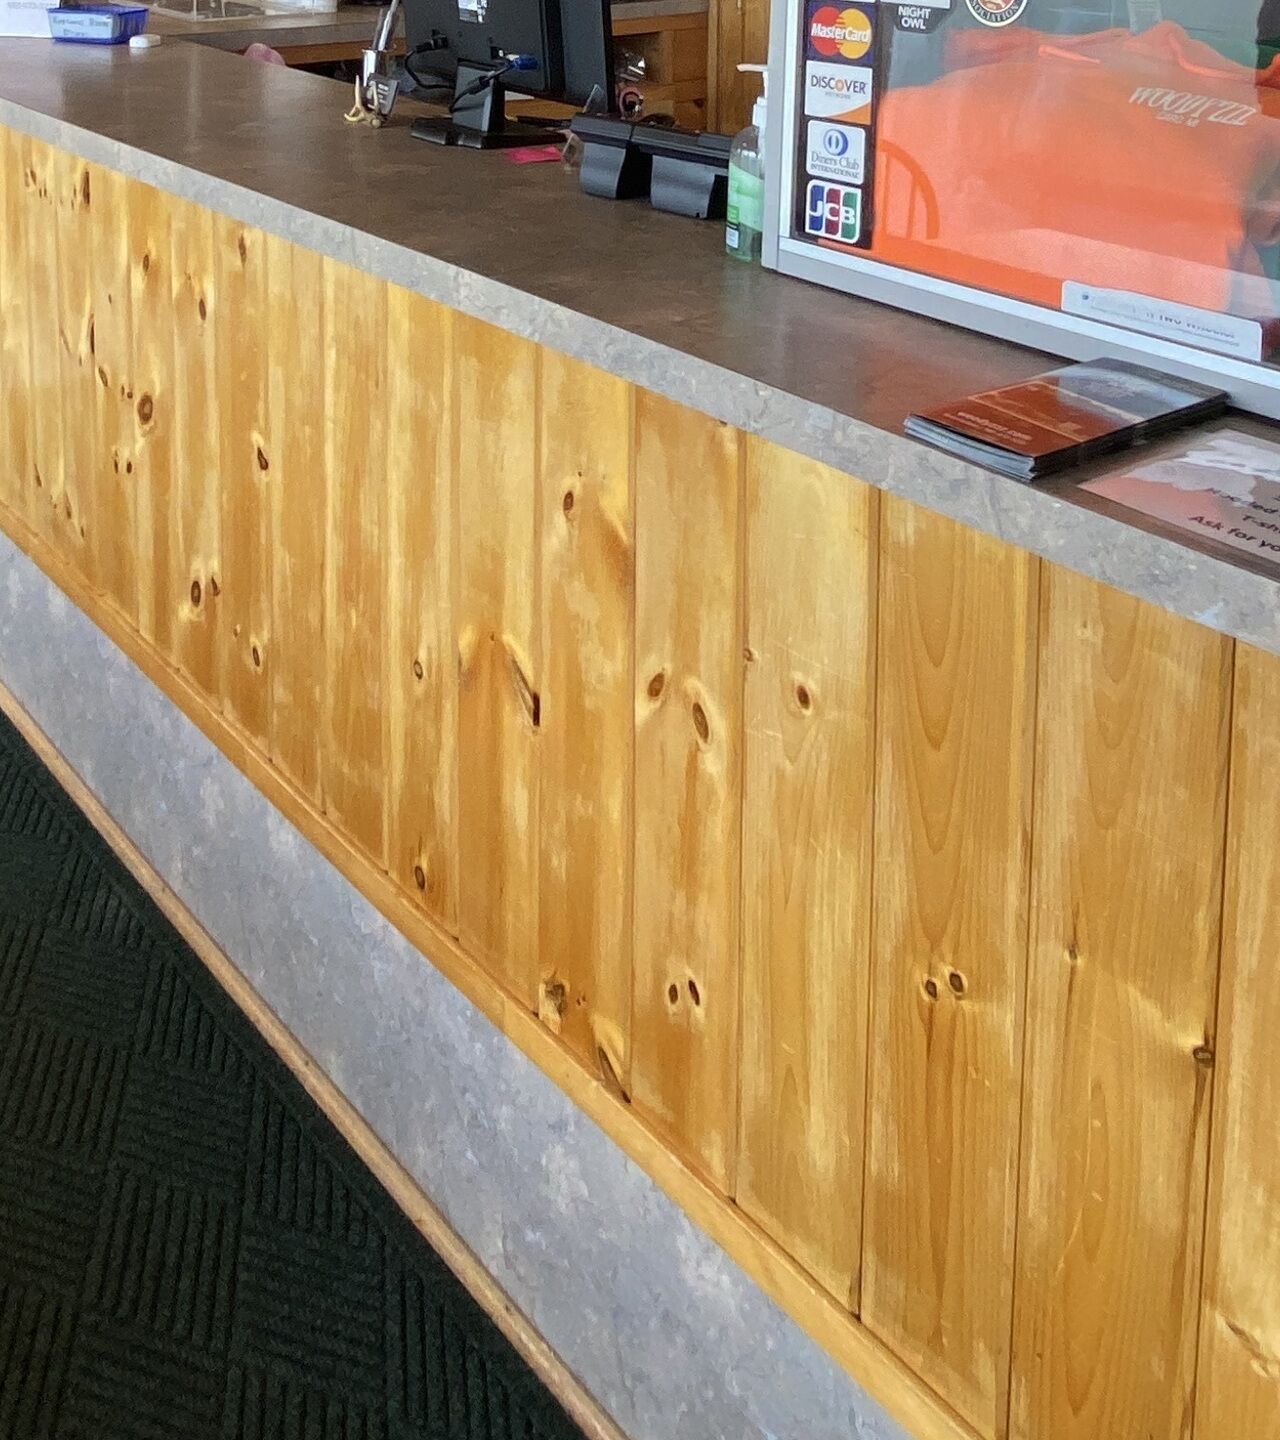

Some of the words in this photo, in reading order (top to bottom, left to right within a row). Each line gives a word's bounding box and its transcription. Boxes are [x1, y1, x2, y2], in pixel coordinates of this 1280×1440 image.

[898, 5, 932, 19] NIGHT
[811, 22, 871, 44] MasterCard
[901, 17, 926, 30] OWL
[811, 75, 866, 95] DISCOVER
[811, 151, 838, 167] Diners
[839, 156, 860, 171] Club
[810, 164, 859, 179] INTERNATIONAL
[809, 200, 856, 225] JCB
[1188, 516, 1224, 531] Ask
[1227, 528, 1257, 541] for
